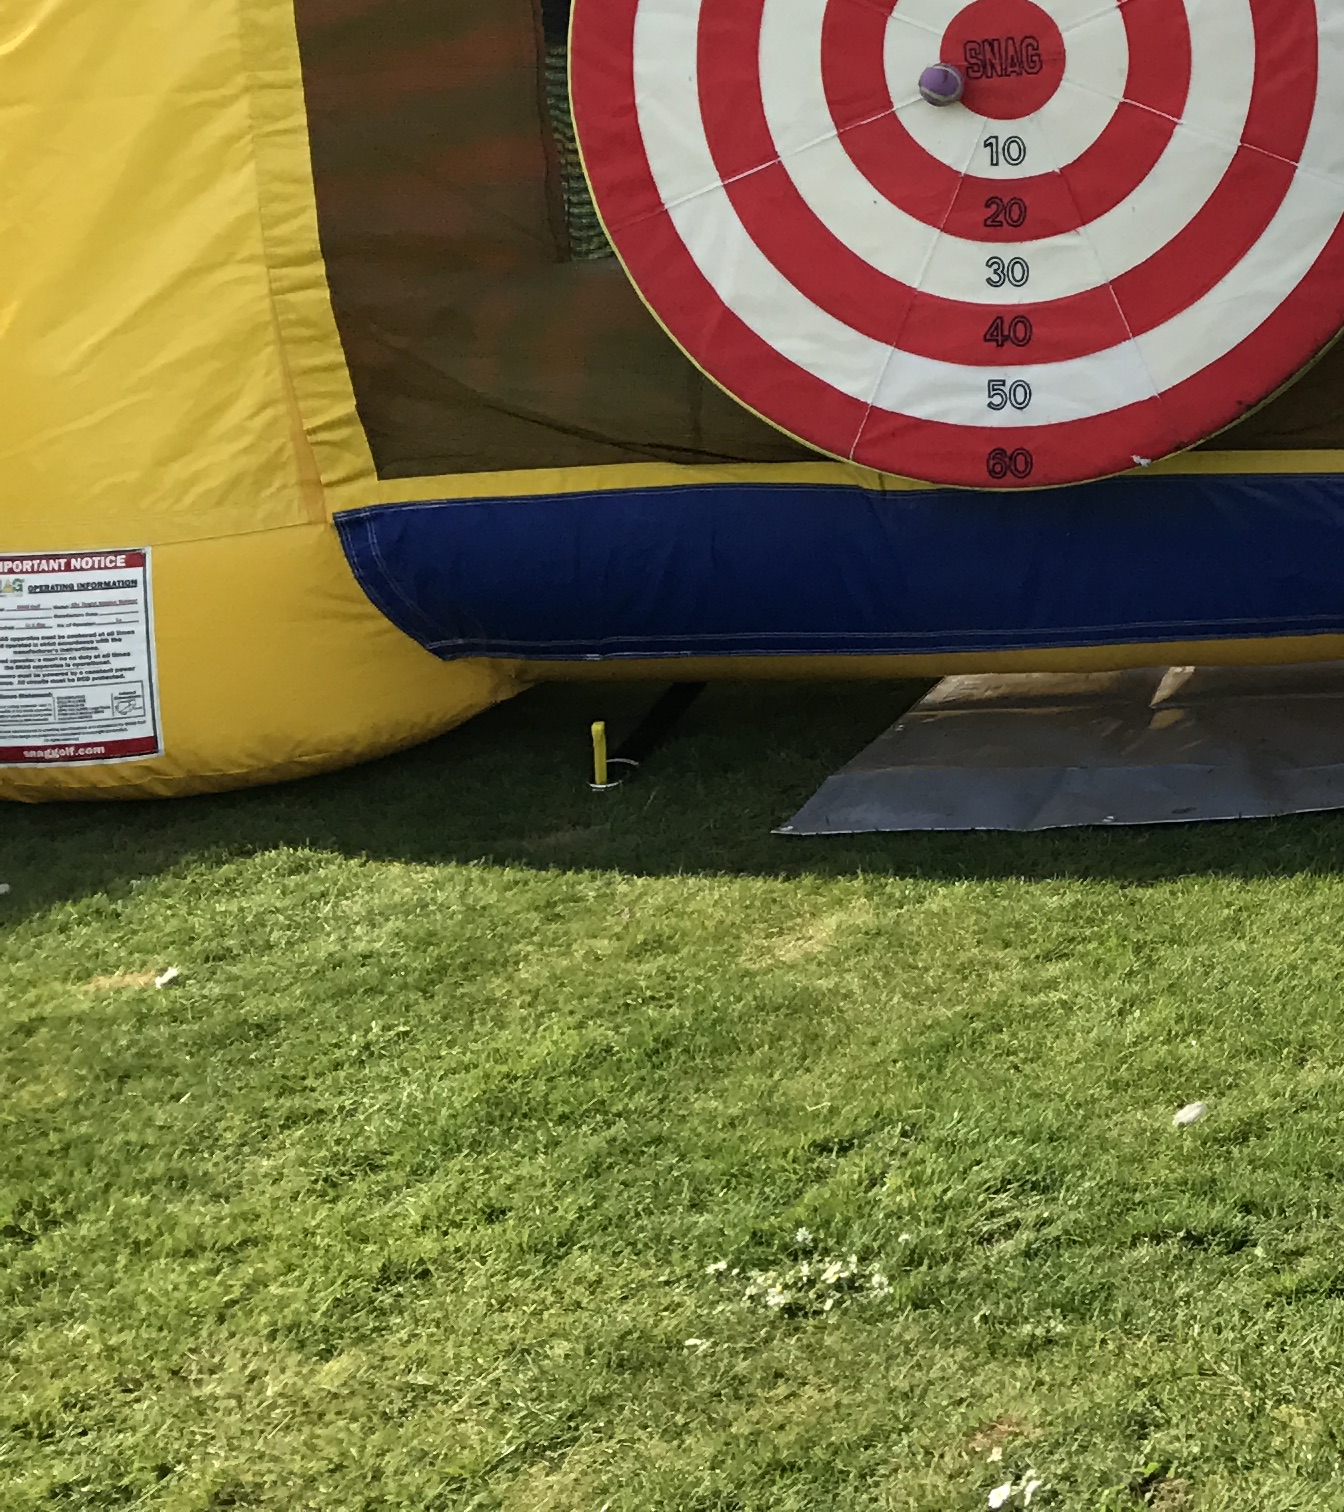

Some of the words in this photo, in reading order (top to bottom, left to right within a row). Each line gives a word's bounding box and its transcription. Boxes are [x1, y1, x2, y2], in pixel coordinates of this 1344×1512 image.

[963, 36, 1042, 80] SNAG
[983, 135, 1027, 166] 10
[984, 196, 1028, 228] 20
[985, 256, 1030, 288] 30
[983, 315, 1033, 348] 40
[986, 379, 1032, 411] 50
[986, 447, 1034, 479] 60
[71, 554, 126, 569] NOTICE
[28, 583, 75, 593] OPERATING
[76, 579, 138, 589] INFORMATION
[23, 746, 105, 759] snaggolf.com
